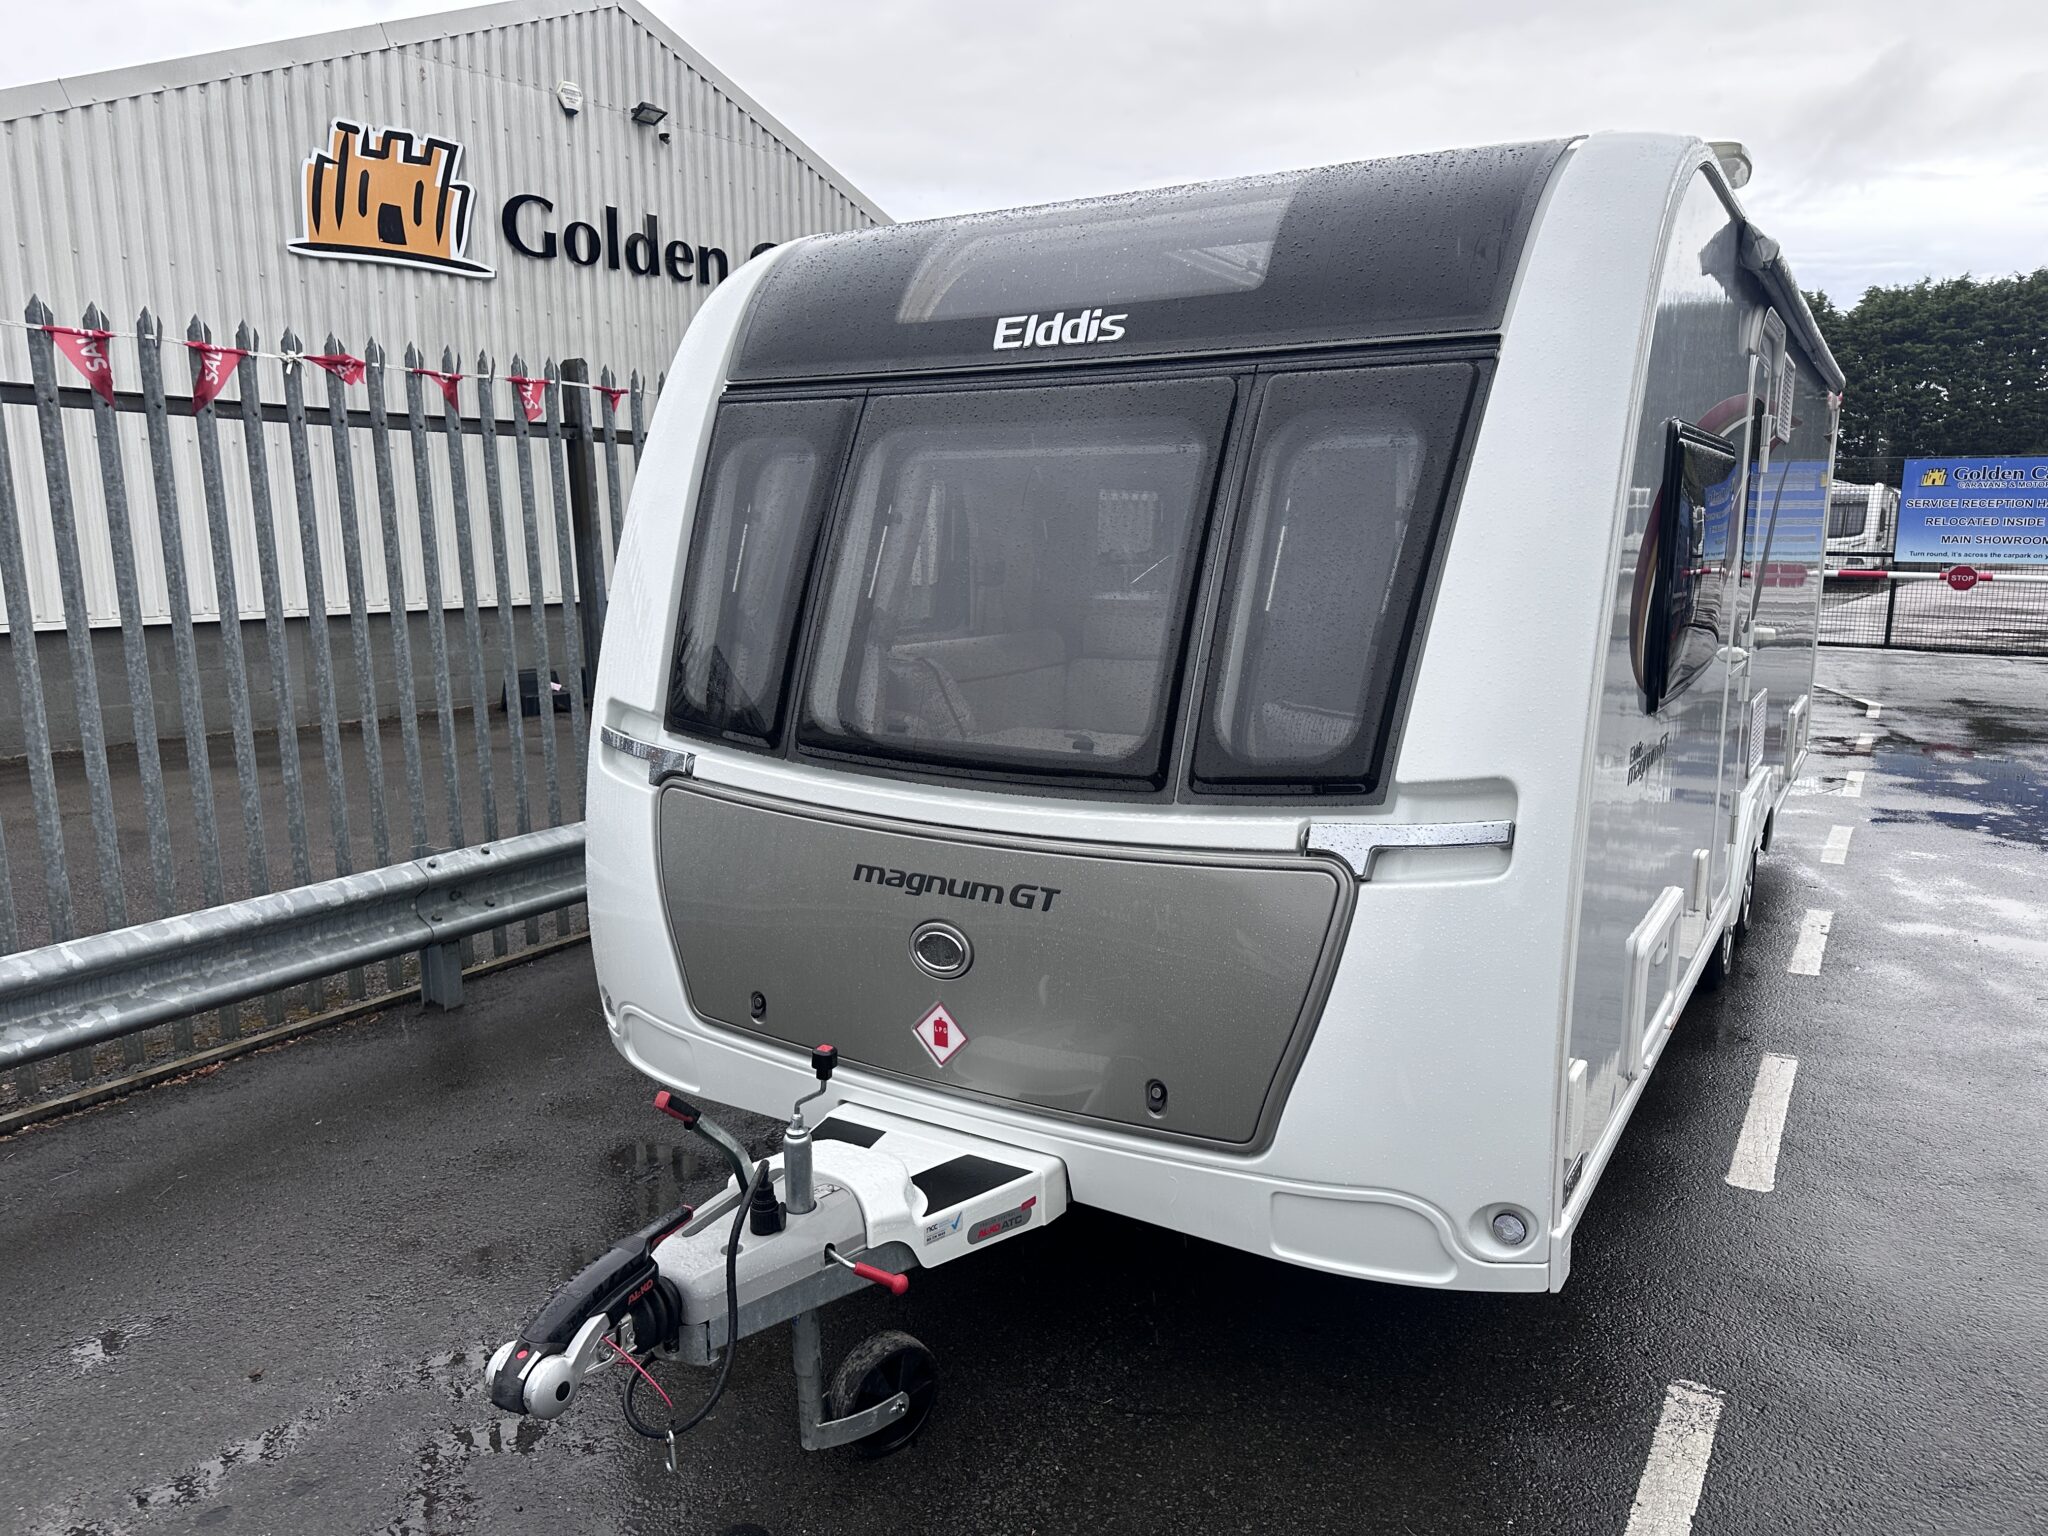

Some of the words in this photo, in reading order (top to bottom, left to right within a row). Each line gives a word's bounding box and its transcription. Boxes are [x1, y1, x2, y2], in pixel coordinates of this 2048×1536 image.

[502, 194, 728, 285] Golden
[993, 308, 1129, 351] Elddis
[1953, 465, 2026, 481] Golden
[2031, 466, 2048, 481] C
[1958, 481, 2007, 489] CARAVANS
[1906, 498, 1960, 509] SERVICE
[1961, 499, 2034, 509] RECEPTION
[1925, 516, 2000, 527] RELOCATED
[2002, 517, 2046, 528] INSIDE
[1941, 535, 1972, 545] MAIN
[1926, 550, 1950, 558] round,
[2003, 552, 2031, 560] carpark
[852, 863, 1005, 905] magnum
[1008, 883, 1061, 912] GT
[934, 1026, 948, 1034] LPG
[1001, 1215, 1023, 1230] ATC
